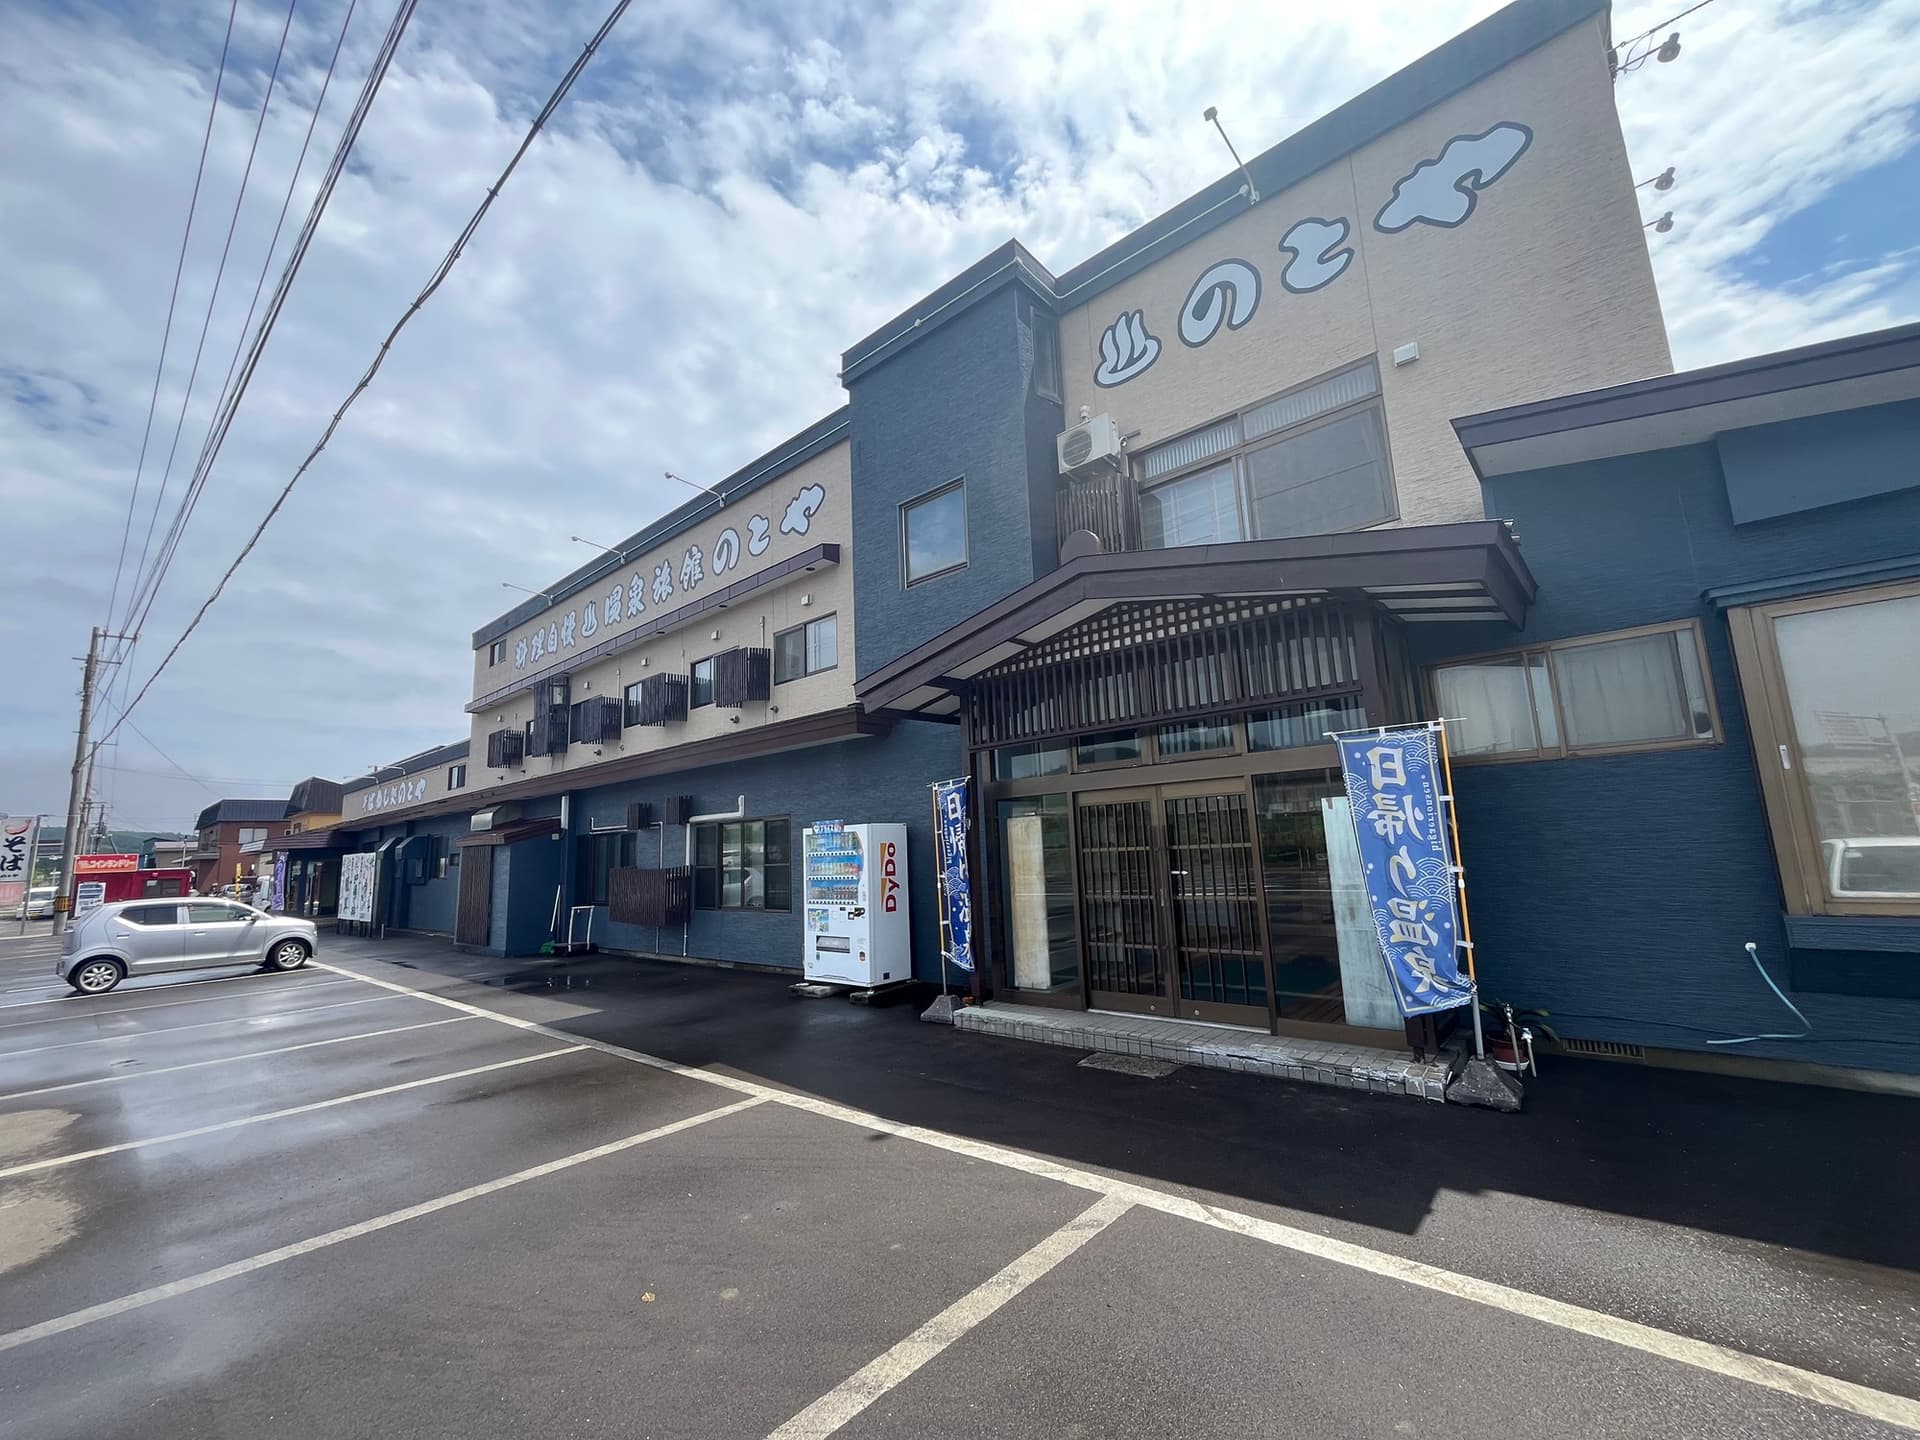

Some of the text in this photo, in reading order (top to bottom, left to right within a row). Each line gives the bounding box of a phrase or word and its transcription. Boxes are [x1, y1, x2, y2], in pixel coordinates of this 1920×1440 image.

[1177, 120, 1533, 349] のとや
[0, 836, 26, 871] そば
